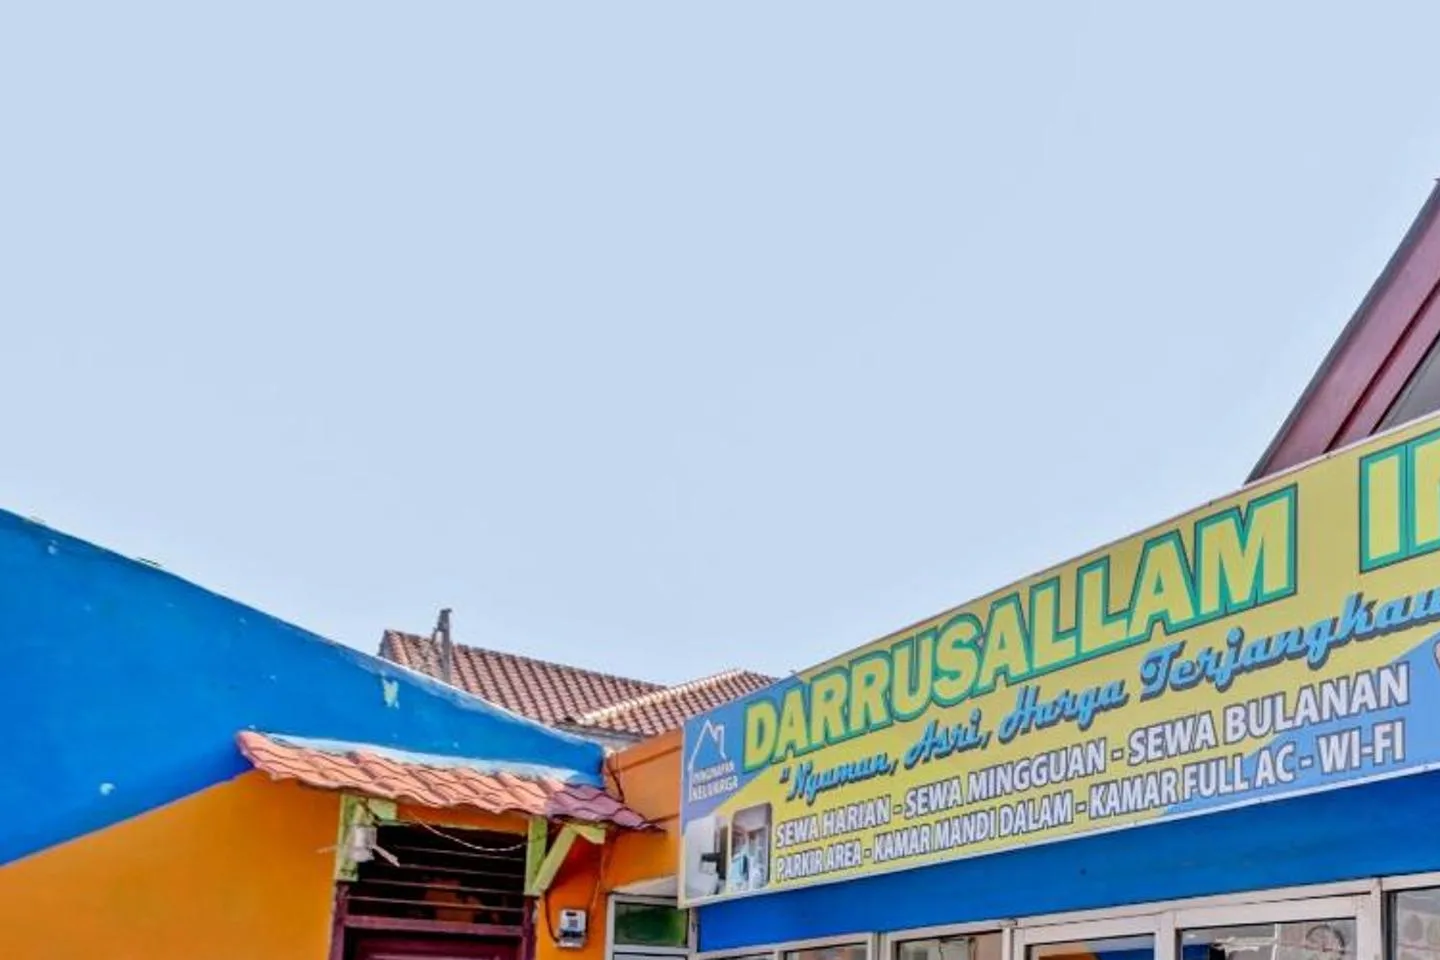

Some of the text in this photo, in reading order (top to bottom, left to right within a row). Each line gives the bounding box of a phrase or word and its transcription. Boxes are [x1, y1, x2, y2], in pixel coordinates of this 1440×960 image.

[743, 482, 1299, 773] DARRUSALLAM
[776, 814, 820, 849] SEWA
[821, 794, 892, 837] HARIAN
[904, 776, 964, 820] SEWA
[966, 737, 1107, 804] MINGGUAN
[1128, 711, 1219, 766] SEWA
[1223, 660, 1411, 745] BULANAN
[776, 846, 824, 883] PARKIR
[825, 838, 864, 871] AREA
[873, 823, 933, 864] KAMAR
[934, 804, 996, 853] MANDI
[998, 789, 1074, 838] DALAM
[1089, 767, 1180, 819] KAMAR
[1182, 750, 1250, 801] FULL
[1254, 736, 1298, 788] AC
[1317, 718, 1406, 776] WI-FI
[904, 708, 991, 769] Asri,
[998, 684, 1129, 743] Harga
